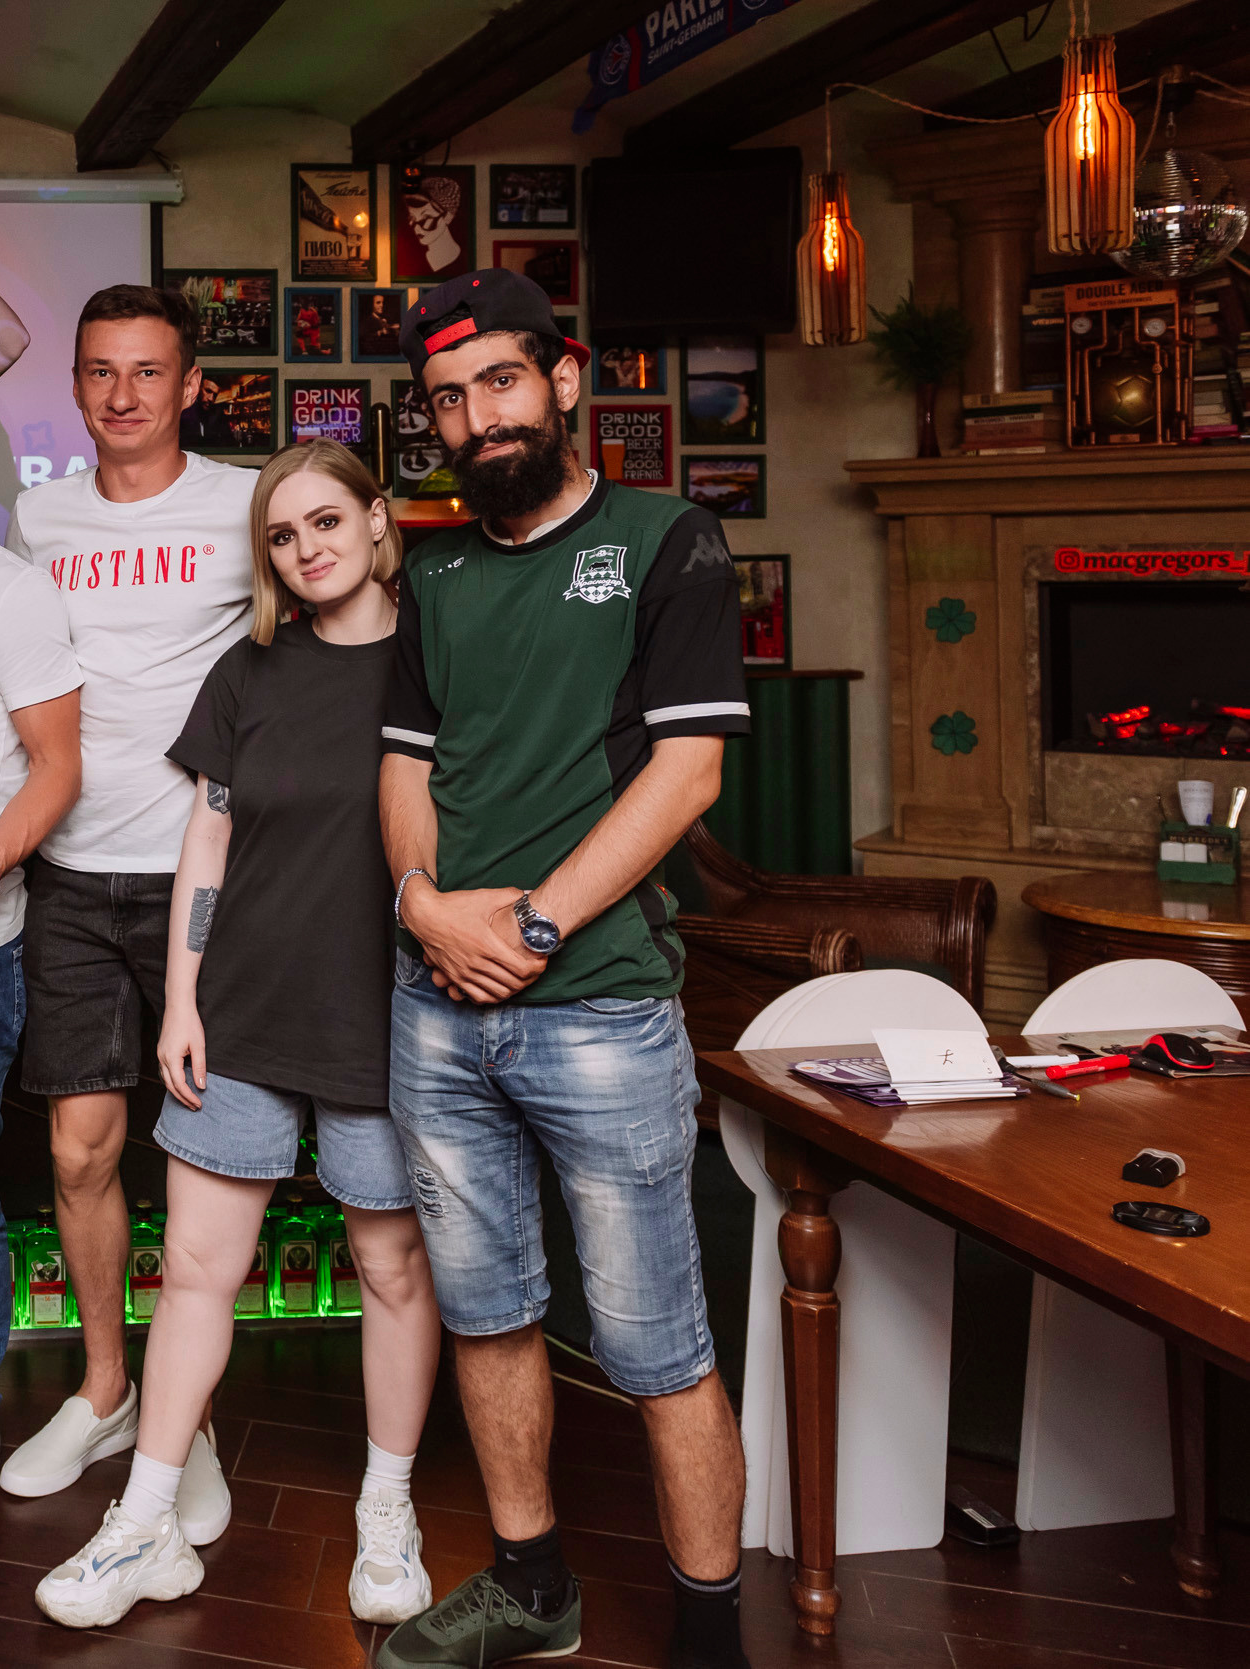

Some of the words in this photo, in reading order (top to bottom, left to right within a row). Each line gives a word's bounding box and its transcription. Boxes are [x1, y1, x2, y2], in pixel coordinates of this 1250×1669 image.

[647, 8, 724, 64] SAINT-GERMAIN
[305, 241, 343, 256] ПИВО
[1076, 283, 1127, 300] DOUBLE
[295, 388, 361, 405] DRINK
[295, 406, 361, 425] GOOD
[600, 412, 661, 424] DRINK
[323, 427, 362, 443] BEER
[600, 425, 662, 437] GOOD
[626, 438, 662, 450] BEER
[625, 460, 663, 469] GOOD
[625, 469, 664, 480] FRIENDS
[1084, 553, 1250, 574] macgregors_
